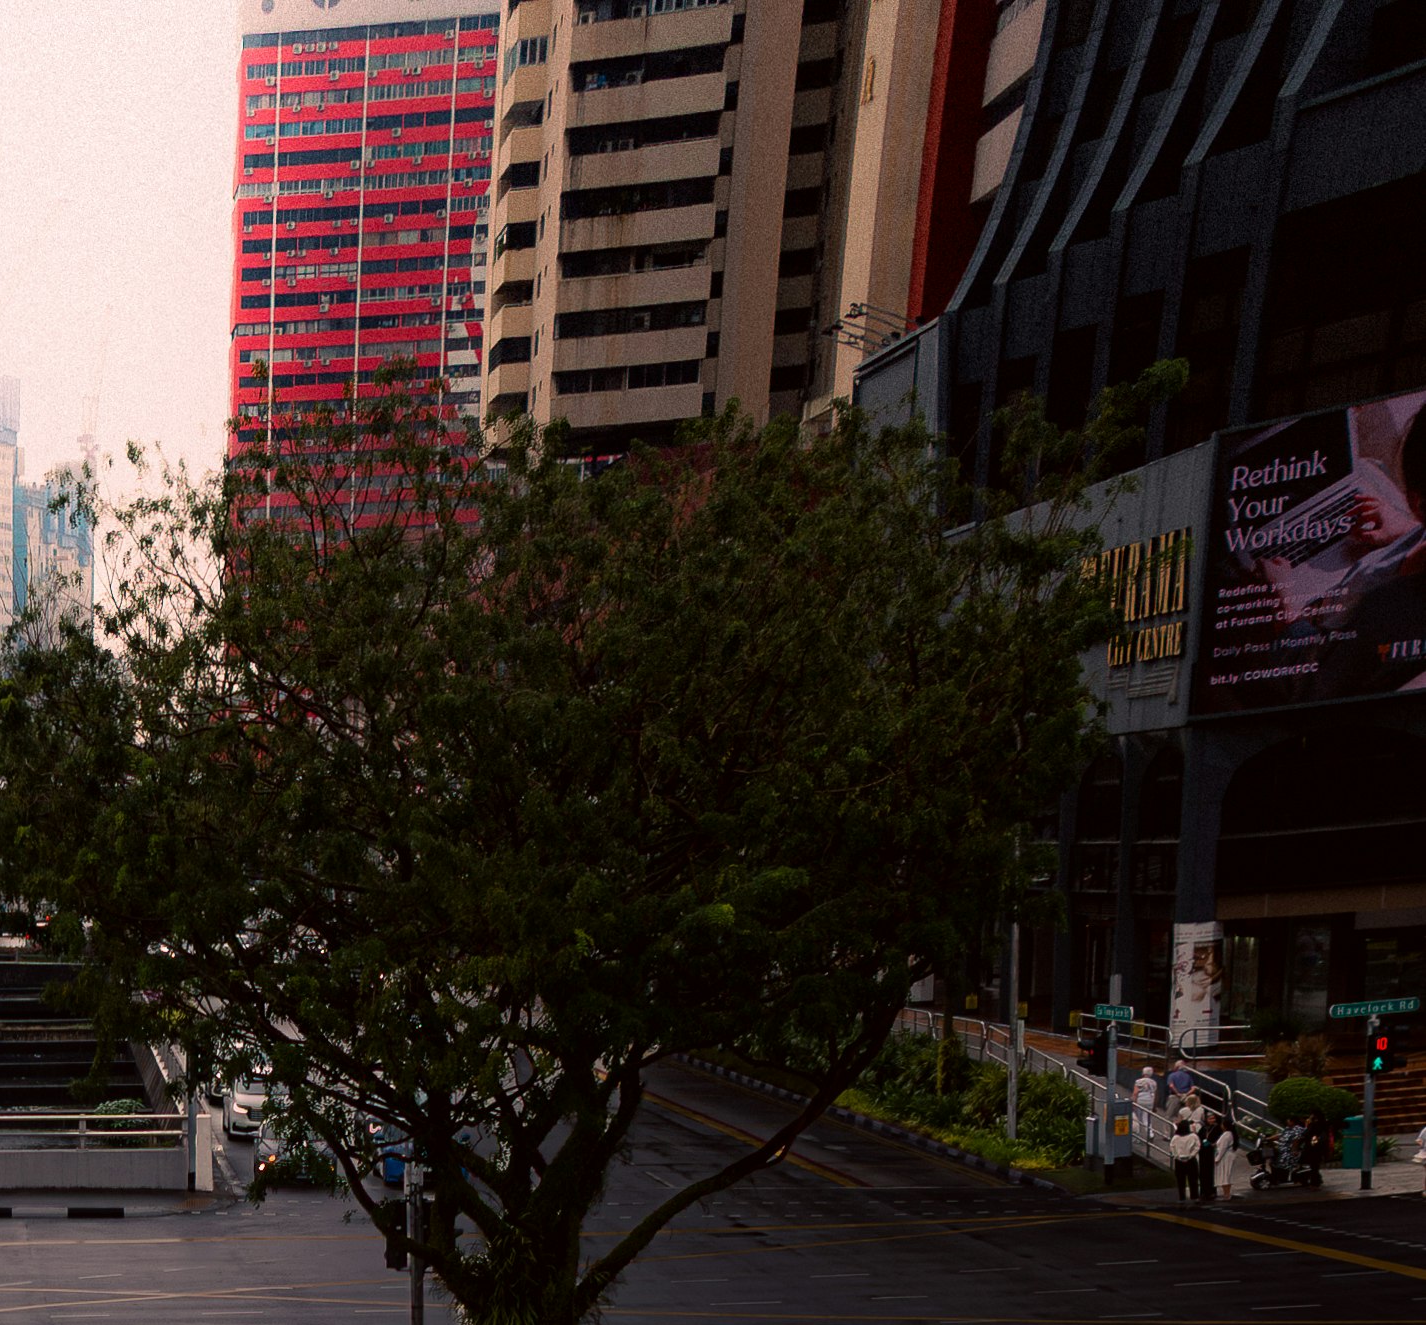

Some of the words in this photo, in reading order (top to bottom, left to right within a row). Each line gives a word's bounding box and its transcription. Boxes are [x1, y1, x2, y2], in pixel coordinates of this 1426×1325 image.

[1230, 449, 1329, 491] Rethink
[1228, 495, 1290, 523] Your
[1223, 514, 1355, 553] Workdays
[1100, 527, 1188, 623] FURAMA
[1217, 583, 1269, 599] Redefine
[1270, 581, 1298, 593] you
[1216, 598, 1281, 615] co-working
[1214, 620, 1229, 630] at
[1230, 614, 1274, 628] Furama
[1136, 621, 1184, 662] CENTRE
[1213, 646, 1242, 660] Daily
[1243, 641, 1271, 654] Pass
[1280, 633, 1327, 650] Monthly
[1328, 629, 1359, 642] Pass
[1391, 639, 1426, 659] FUR
[1336, 1002, 1394, 1016] Havelock
[1399, 1000, 1415, 1010] Rd
[1376, 1036, 1389, 1051] 10
